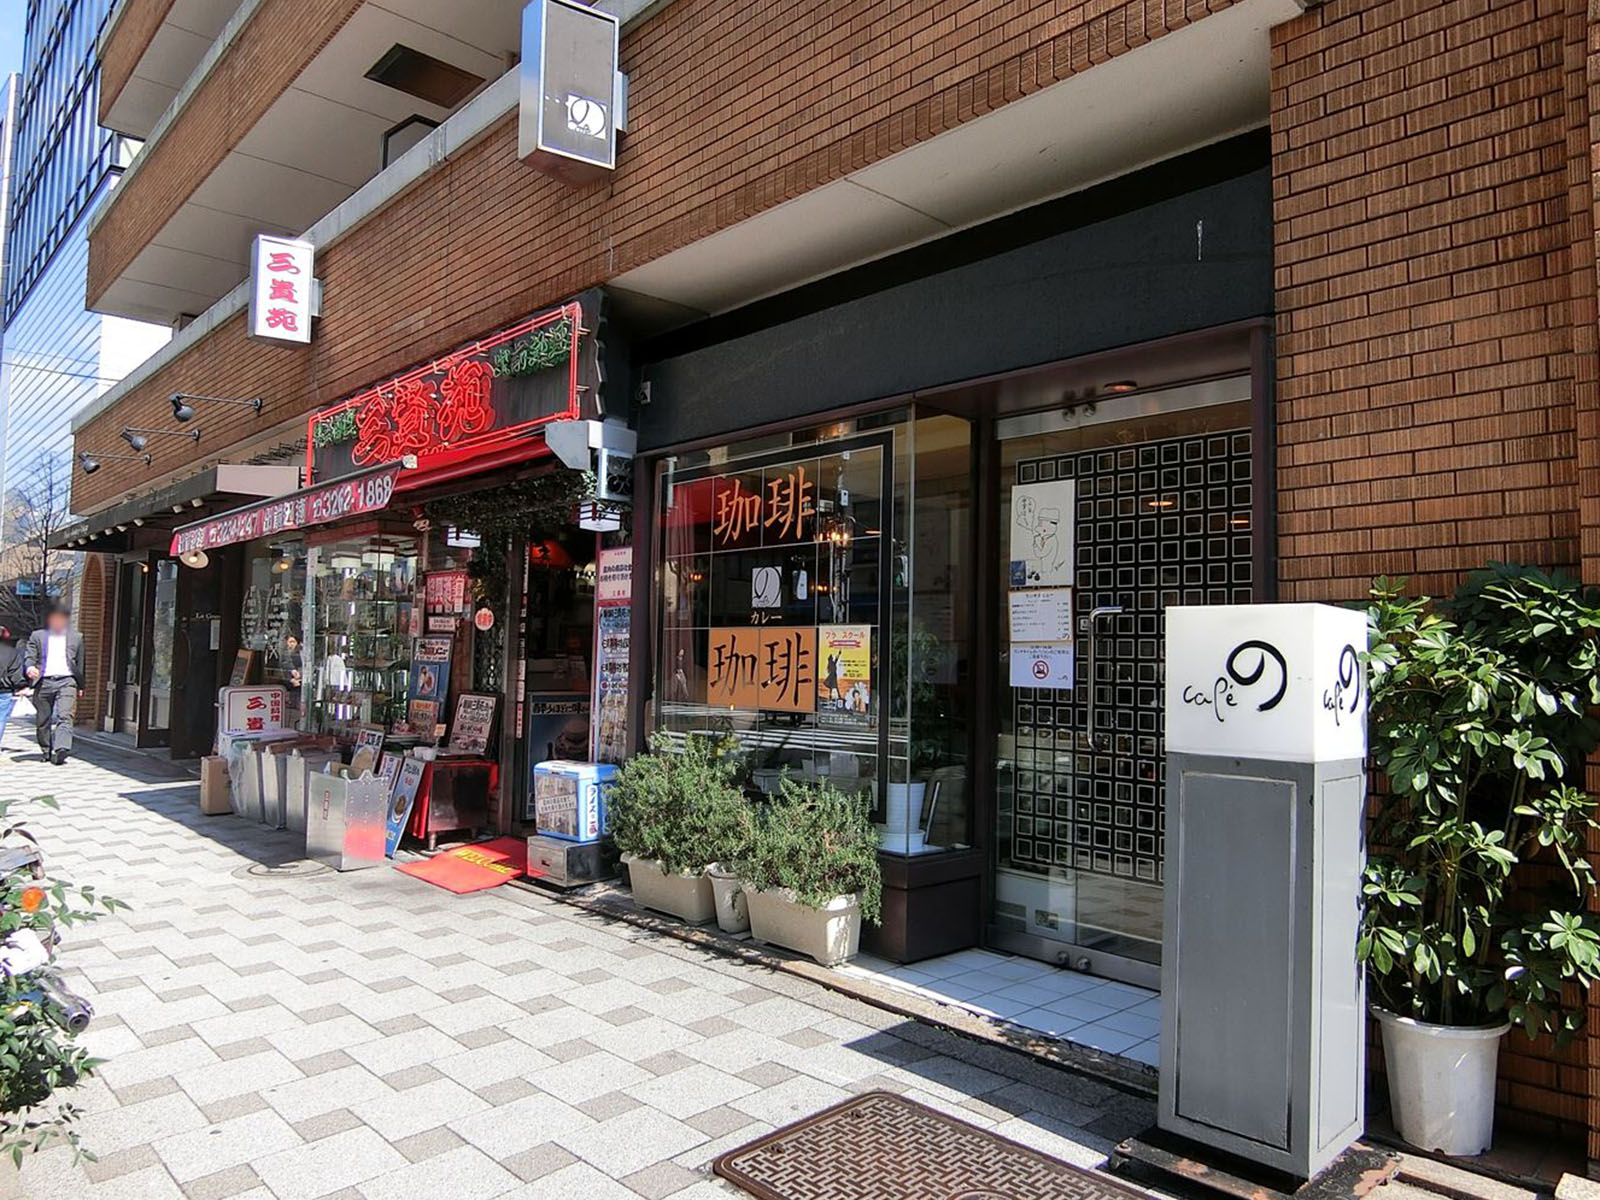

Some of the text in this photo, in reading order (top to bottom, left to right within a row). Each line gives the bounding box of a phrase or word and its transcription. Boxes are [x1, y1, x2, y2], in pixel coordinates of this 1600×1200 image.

[713, 466, 816, 545] 珈琲
[750, 610, 783, 625] カレー
[709, 631, 812, 707] 珈琲
[1226, 640, 1287, 712] の
